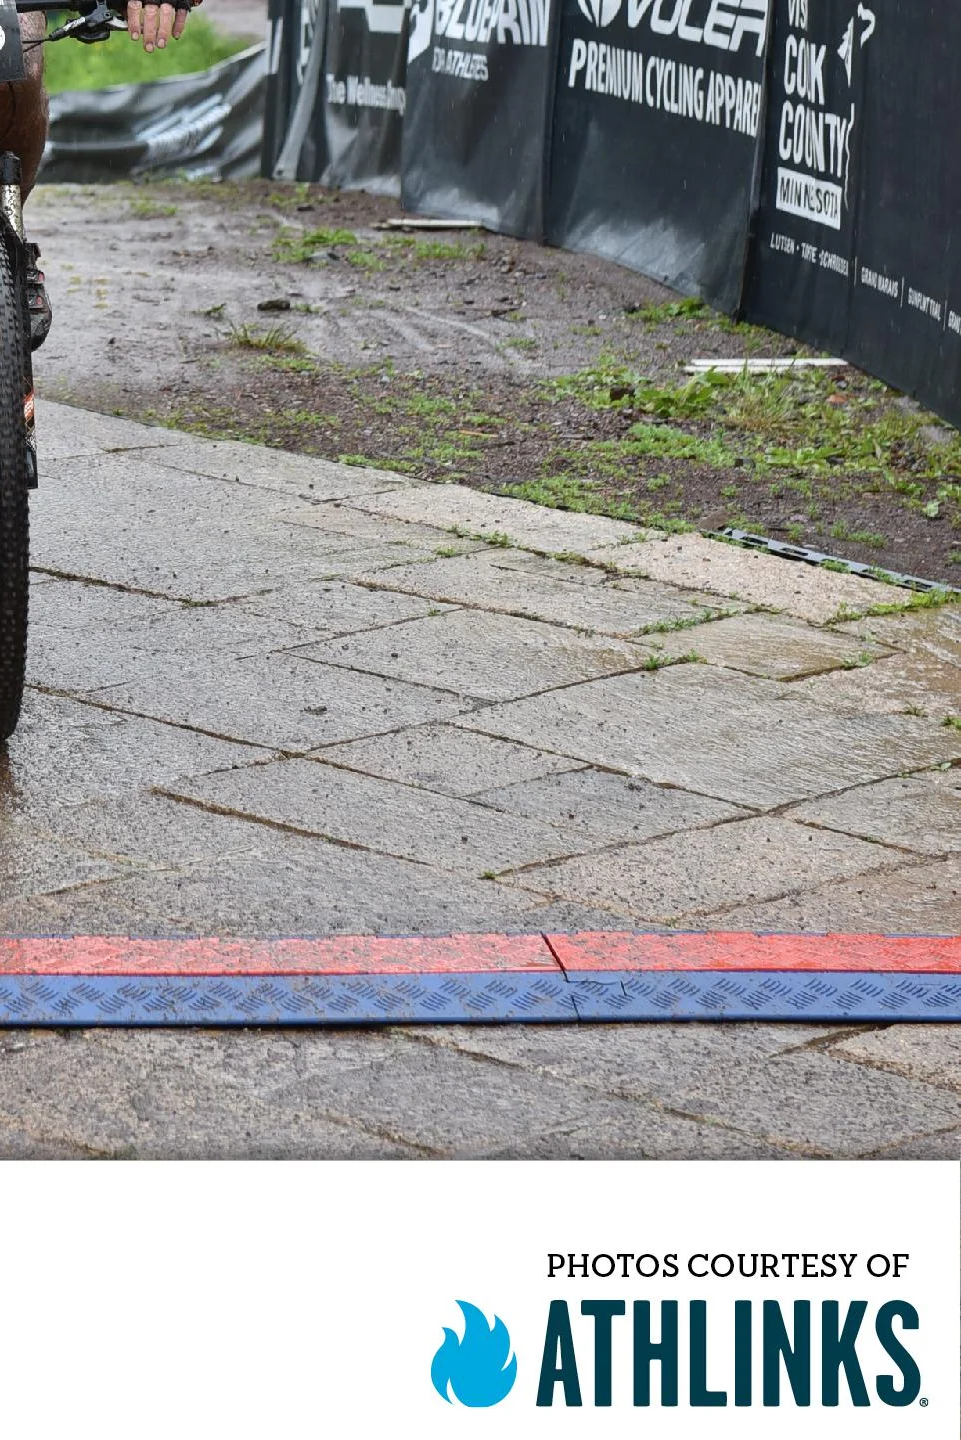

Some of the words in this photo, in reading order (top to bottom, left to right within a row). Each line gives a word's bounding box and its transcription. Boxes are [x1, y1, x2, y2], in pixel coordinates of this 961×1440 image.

[568, 38, 643, 104] PREMIUM
[646, 55, 704, 121] CYCLING
[783, 33, 827, 106] COK
[778, 100, 847, 178] COUNTY
